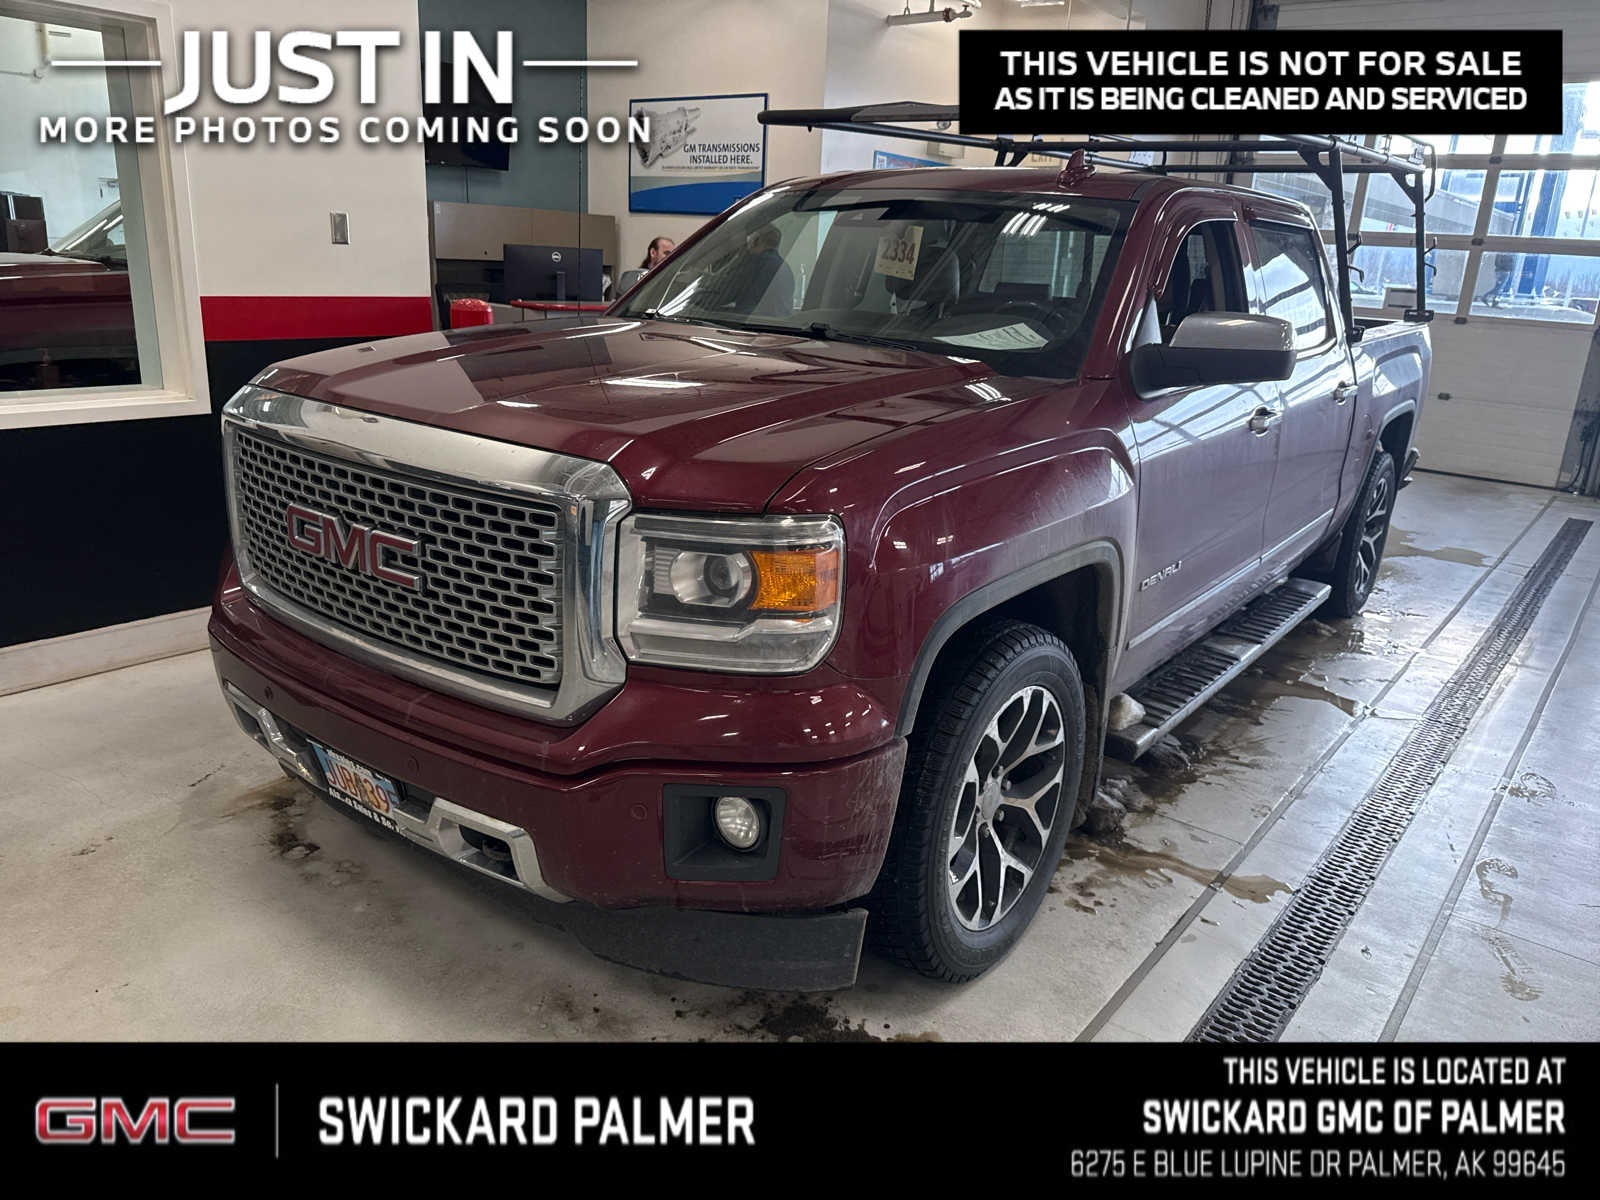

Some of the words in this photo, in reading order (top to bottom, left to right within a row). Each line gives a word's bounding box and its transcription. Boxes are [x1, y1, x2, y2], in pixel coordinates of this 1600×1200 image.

[683, 143, 697, 153] GM
[698, 142, 761, 153] TRANSMISSIONS
[689, 154, 729, 165] INSTALLED
[730, 154, 753, 165] HERE.
[287, 502, 422, 591] GMC
